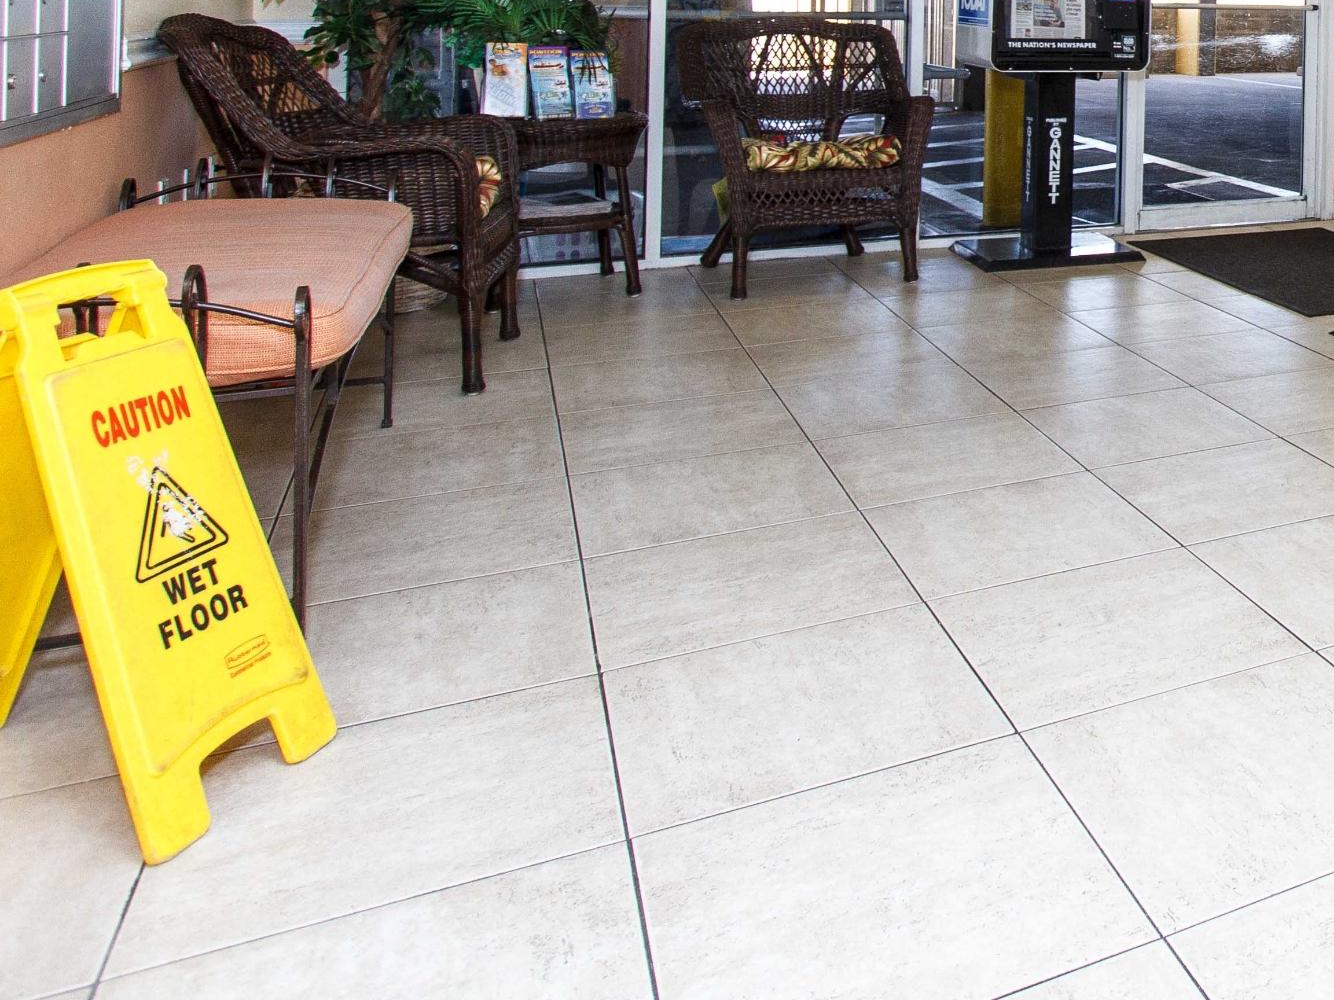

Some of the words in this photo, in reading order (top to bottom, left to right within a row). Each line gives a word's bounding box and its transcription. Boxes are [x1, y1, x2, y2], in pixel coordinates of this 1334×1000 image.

[1048, 127, 1062, 205] GANNETT
[92, 385, 191, 448] CAUTION
[162, 558, 218, 605] WET
[158, 584, 248, 650] FLOOR
